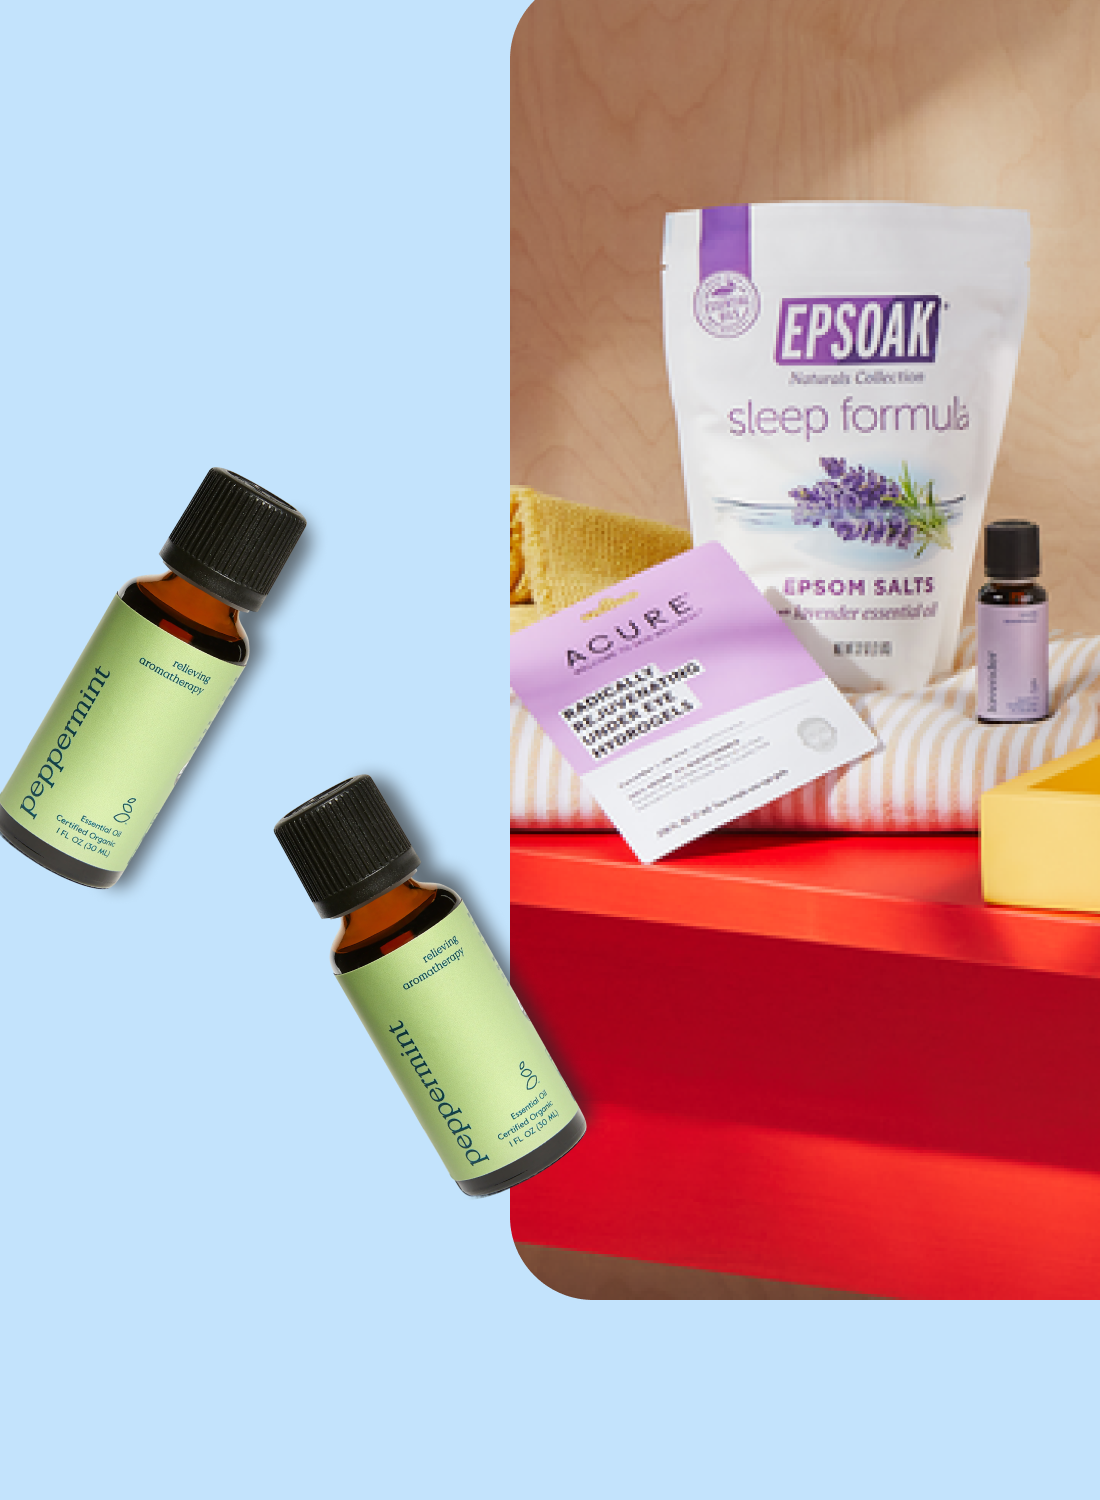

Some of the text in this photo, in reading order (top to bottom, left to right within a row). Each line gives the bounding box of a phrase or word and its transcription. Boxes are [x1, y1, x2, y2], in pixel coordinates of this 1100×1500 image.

[782, 301, 936, 359] EPSOAK
[788, 371, 924, 385] Naturals Collection
[729, 399, 828, 442] sleep
[784, 576, 934, 596] EPSOM SALTS
[565, 595, 691, 668] ACURE
[138, 657, 205, 696] aromatherapy
[172, 660, 212, 685] relieving
[564, 668, 653, 721] RADICALLY
[573, 663, 699, 733] REJUVENATING
[582, 692, 676, 746] UNDER EYE
[592, 700, 693, 758] HYDROGELS
[19, 665, 111, 820] peppermint
[56, 814, 116, 848] Certified Organic
[59, 829, 69, 840] FL
[71, 836, 84, 847] OZ
[84, 842, 97, 853] (30
[98, 848, 111, 859] ML)
[80, 815, 122, 838] Essential Oil
[402, 946, 465, 991] aromatherapy
[422, 935, 459, 963] relieving
[388, 1019, 490, 1166] peppermint
[510, 1089, 548, 1120] Essential Oil
[497, 1100, 554, 1141] Certified Organic
[512, 1135, 524, 1146] FL
[524, 1126, 536, 1138] OZ
[535, 1117, 548, 1133] (30
[547, 1109, 560, 1123] ML)
